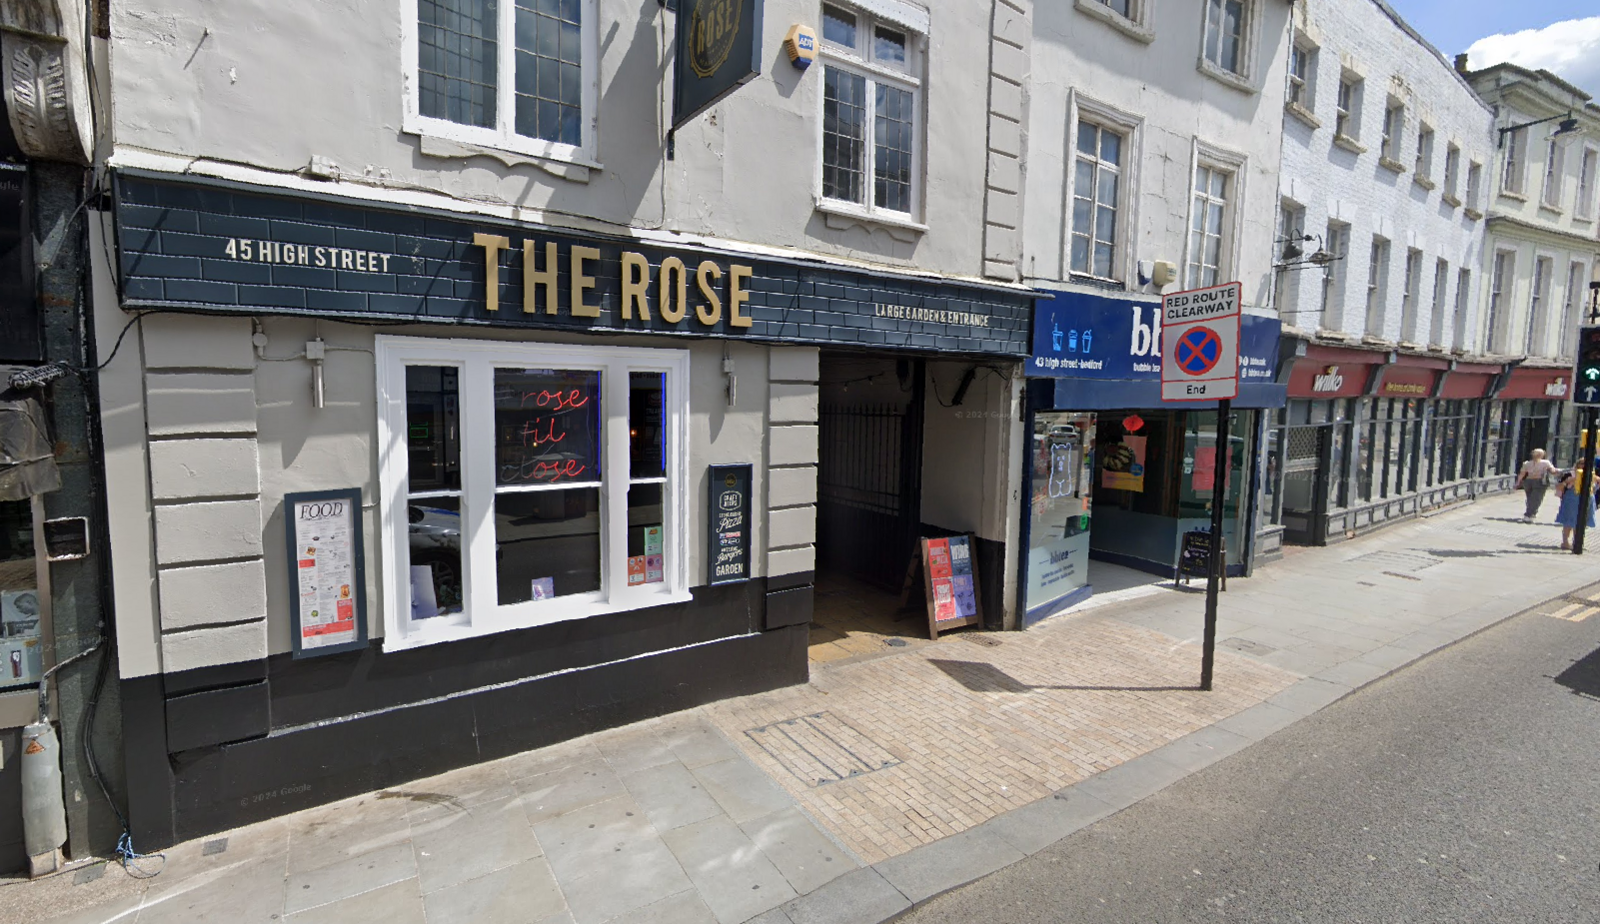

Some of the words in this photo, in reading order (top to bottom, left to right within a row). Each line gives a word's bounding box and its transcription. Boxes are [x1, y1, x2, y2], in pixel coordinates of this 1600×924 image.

[697, 0, 733, 55] ROSE
[225, 238, 252, 261] 45
[259, 241, 309, 266] HIGH
[315, 246, 391, 273] STREET
[473, 232, 600, 318] THE
[621, 251, 753, 328] ROSE
[1166, 296, 1189, 309] RED
[1192, 287, 1235, 304] ROUTE
[875, 303, 905, 319] LARGE
[906, 307, 939, 322] GARDEN
[940, 310, 947, 323] &
[948, 311, 989, 327] ENTRANCE
[1167, 300, 1234, 320] CLEARWAY
[1035, 356, 1044, 368] 43
[1045, 357, 1060, 370] high
[1312, 365, 1343, 392] wilko
[521, 389, 589, 411] rose
[1186, 385, 1206, 395] End
[520, 417, 566, 447] til
[501, 455, 586, 482] close
[300, 502, 343, 520] FOOD
[716, 516, 742, 533] Pizza
[716, 562, 743, 577] GARDEN
